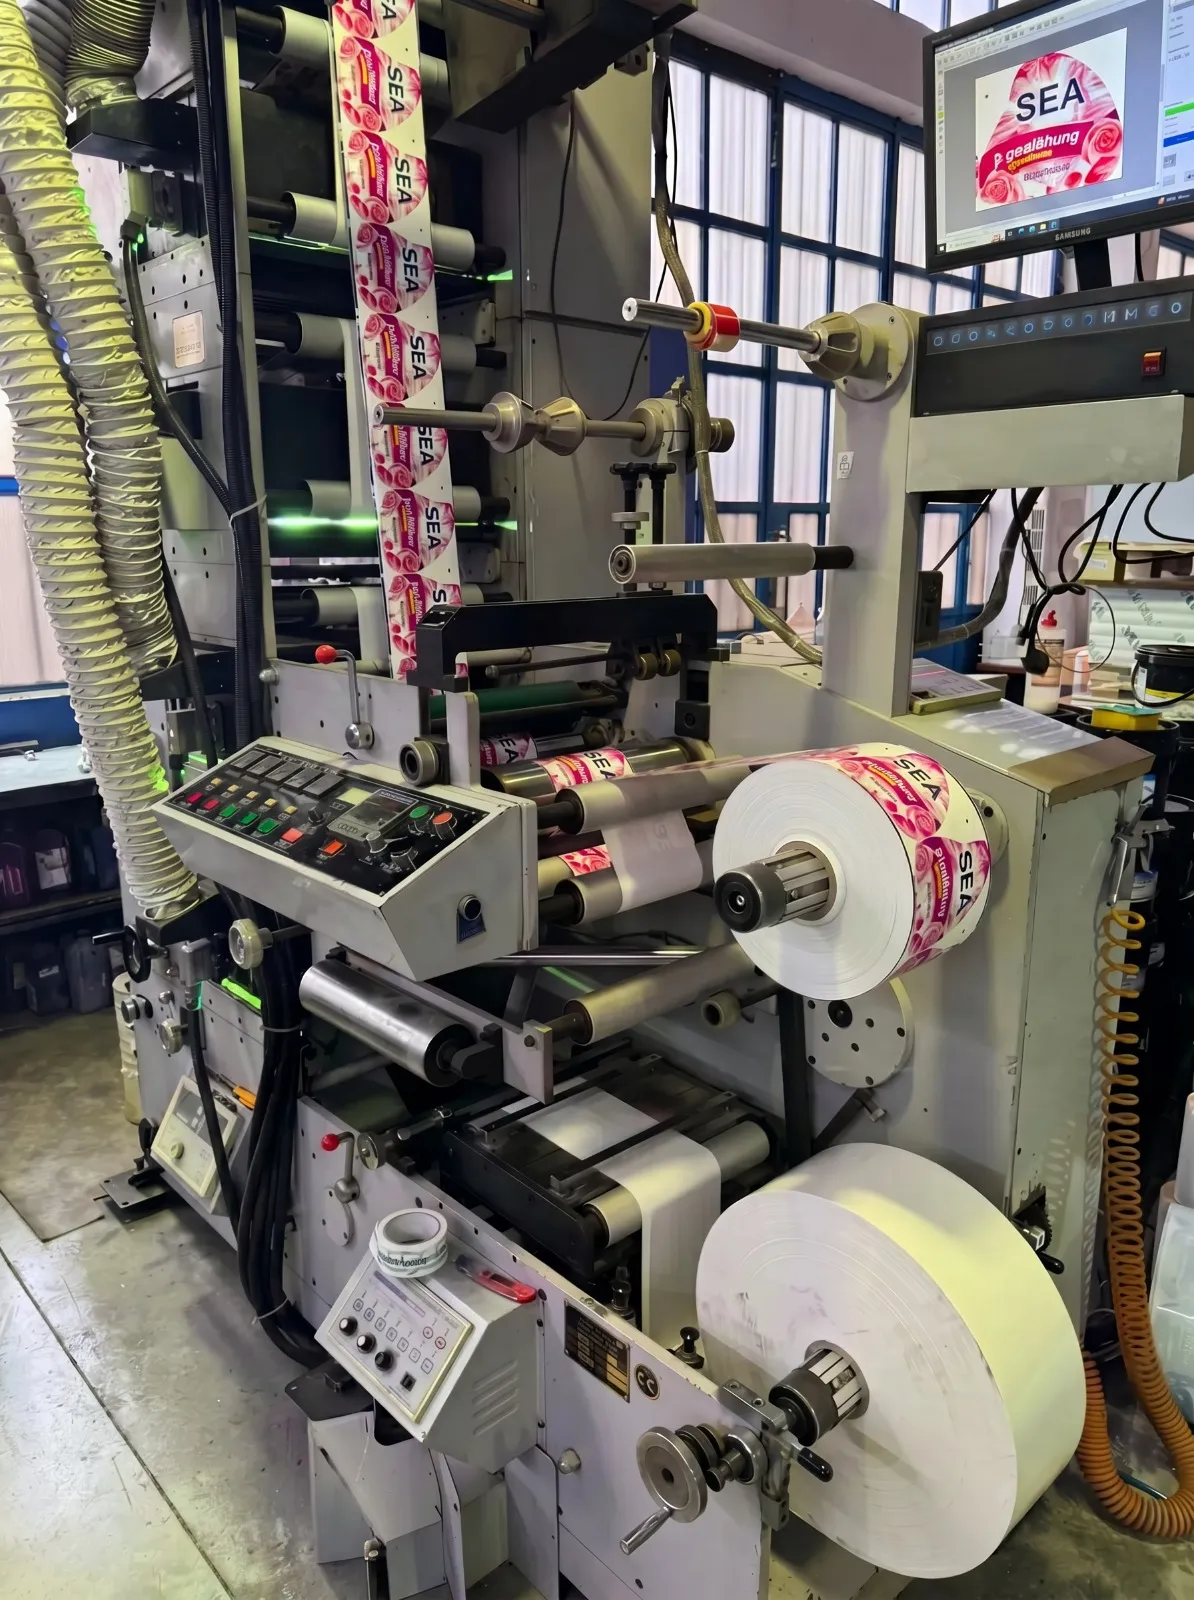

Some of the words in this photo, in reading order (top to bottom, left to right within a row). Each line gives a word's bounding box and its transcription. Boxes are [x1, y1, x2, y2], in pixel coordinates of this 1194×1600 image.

[387, 65, 405, 113] SEA
[1015, 77, 1085, 122] SEA
[395, 157, 413, 204] SEA
[1055, 227, 1091, 241] SAMSUNG
[402, 247, 420, 293] SEA
[410, 335, 427, 380] SEA
[425, 506, 442, 551] SEA
[499, 735, 520, 764] EA
[584, 751, 616, 780] SEA
[893, 758, 942, 802] SEA
[956, 850, 974, 916] SEA
